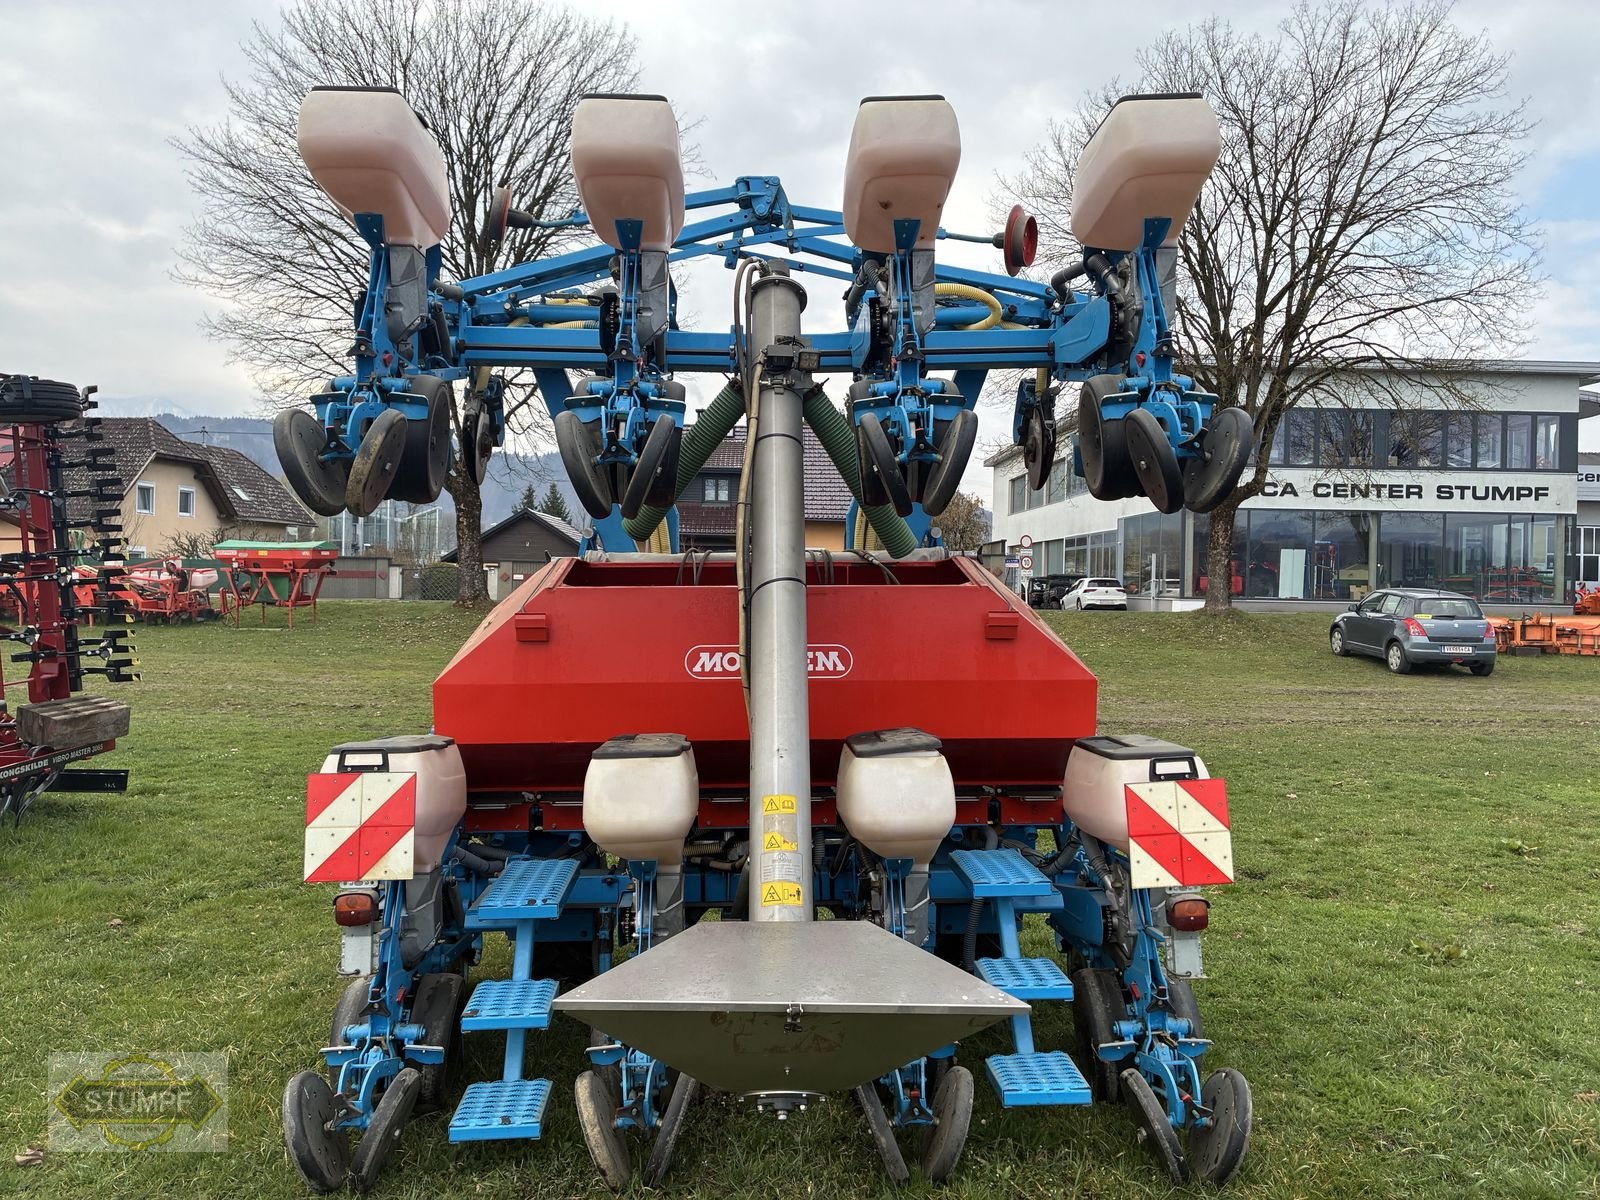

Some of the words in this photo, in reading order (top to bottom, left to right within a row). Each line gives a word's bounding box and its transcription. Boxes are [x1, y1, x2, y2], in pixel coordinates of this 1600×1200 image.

[1313, 482, 1423, 499] CENTER
[1436, 484, 1549, 501] STUMPF
[52, 753, 70, 763] VIBRO
[70, 746, 91, 758] MASTER
